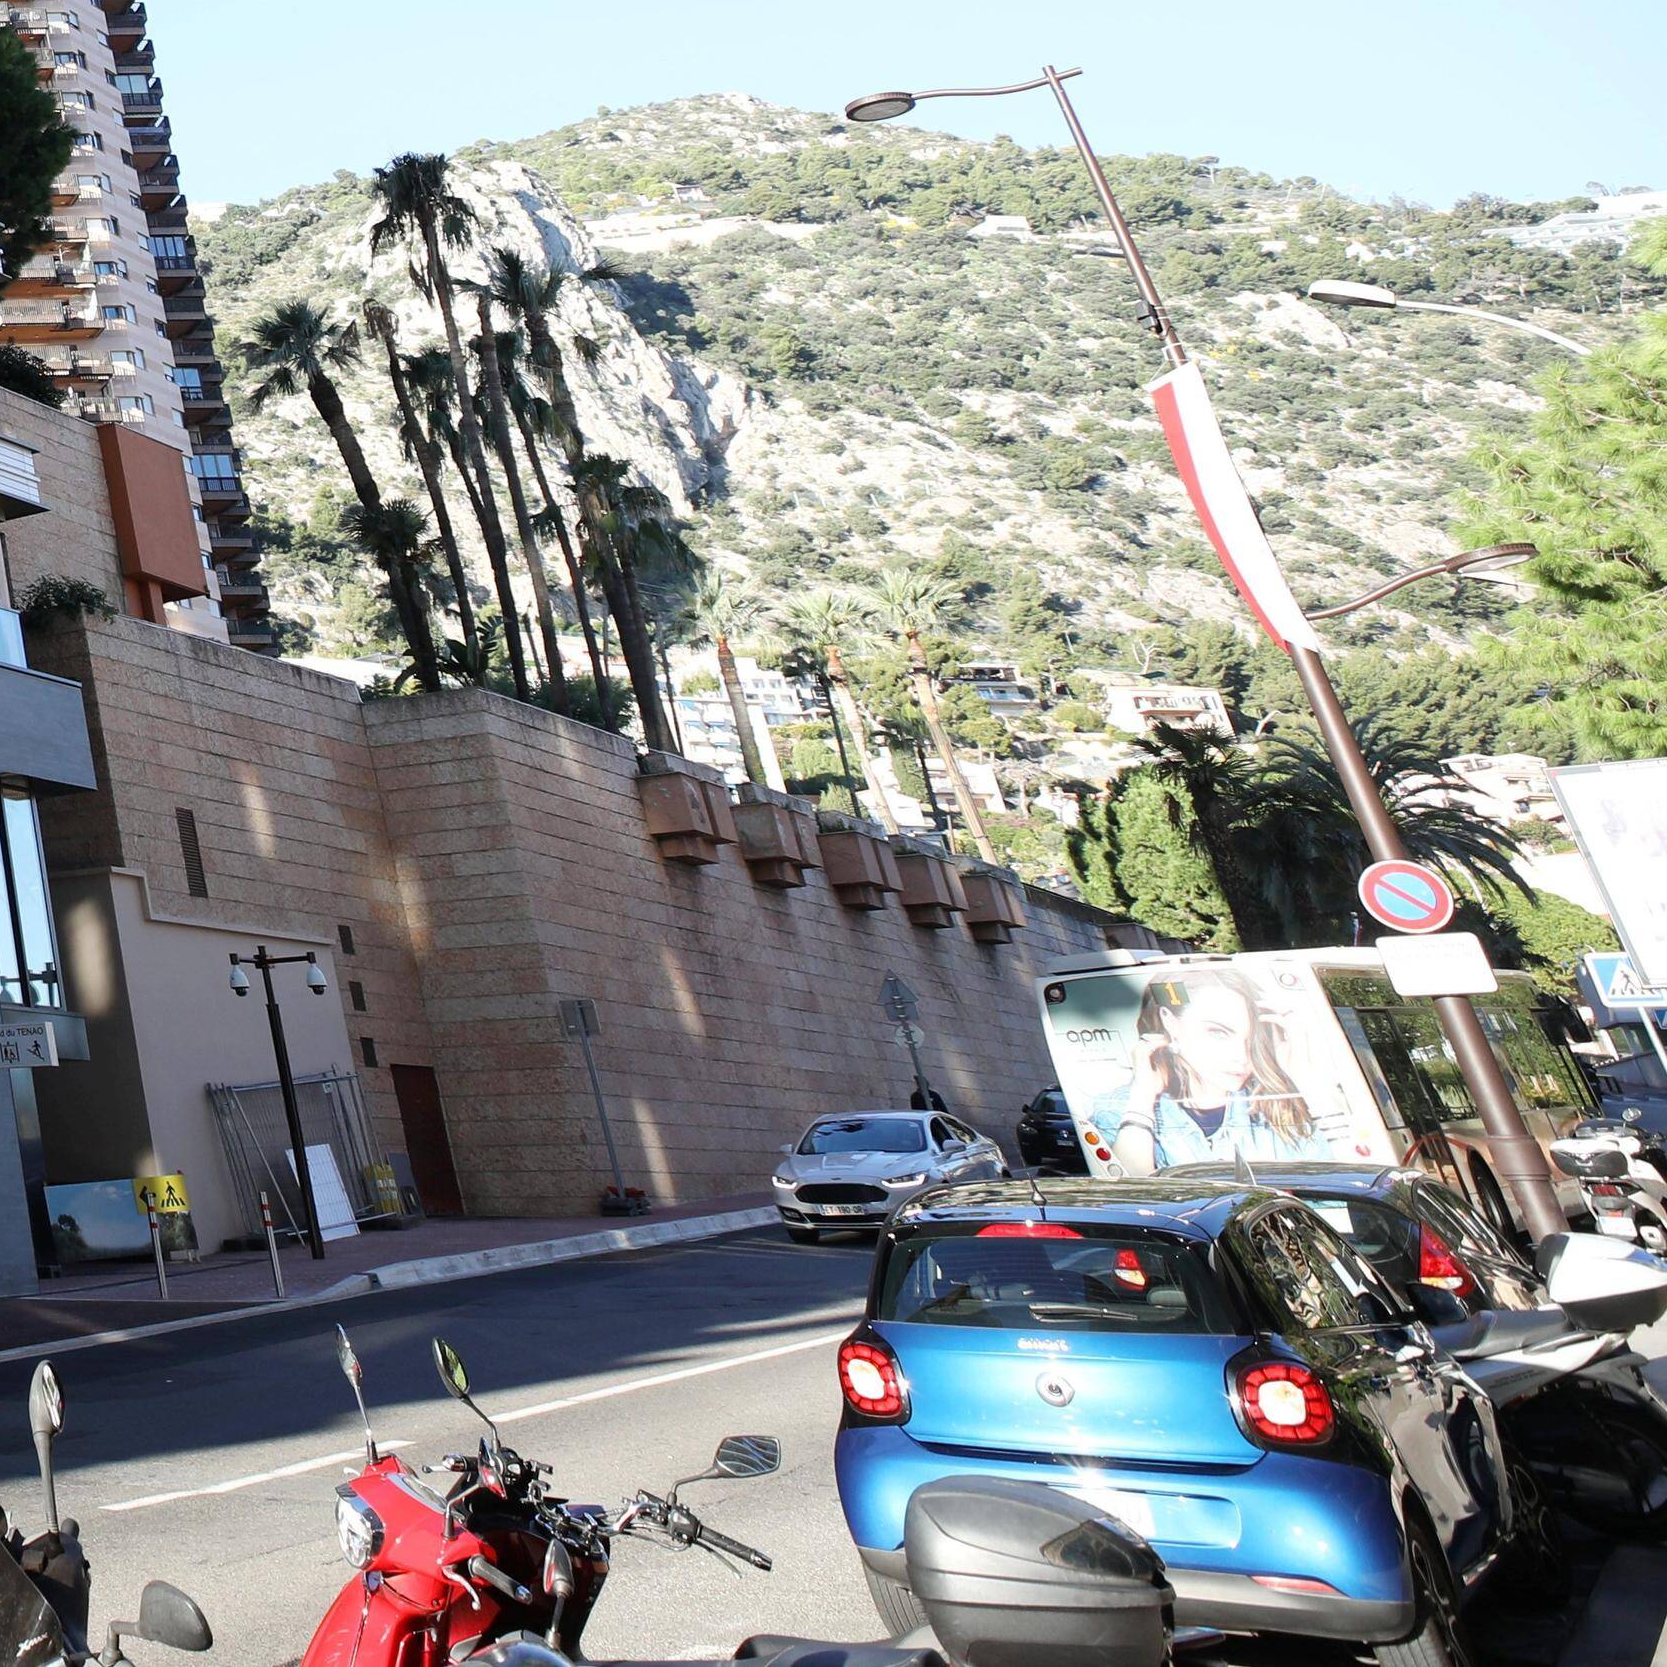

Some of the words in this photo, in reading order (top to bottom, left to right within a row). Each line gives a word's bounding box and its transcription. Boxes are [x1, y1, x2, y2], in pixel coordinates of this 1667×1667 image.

[1164, 982, 1182, 1006] 1
[16, 1026, 44, 1036] TENAO
[1066, 1028, 1112, 1047] apm
